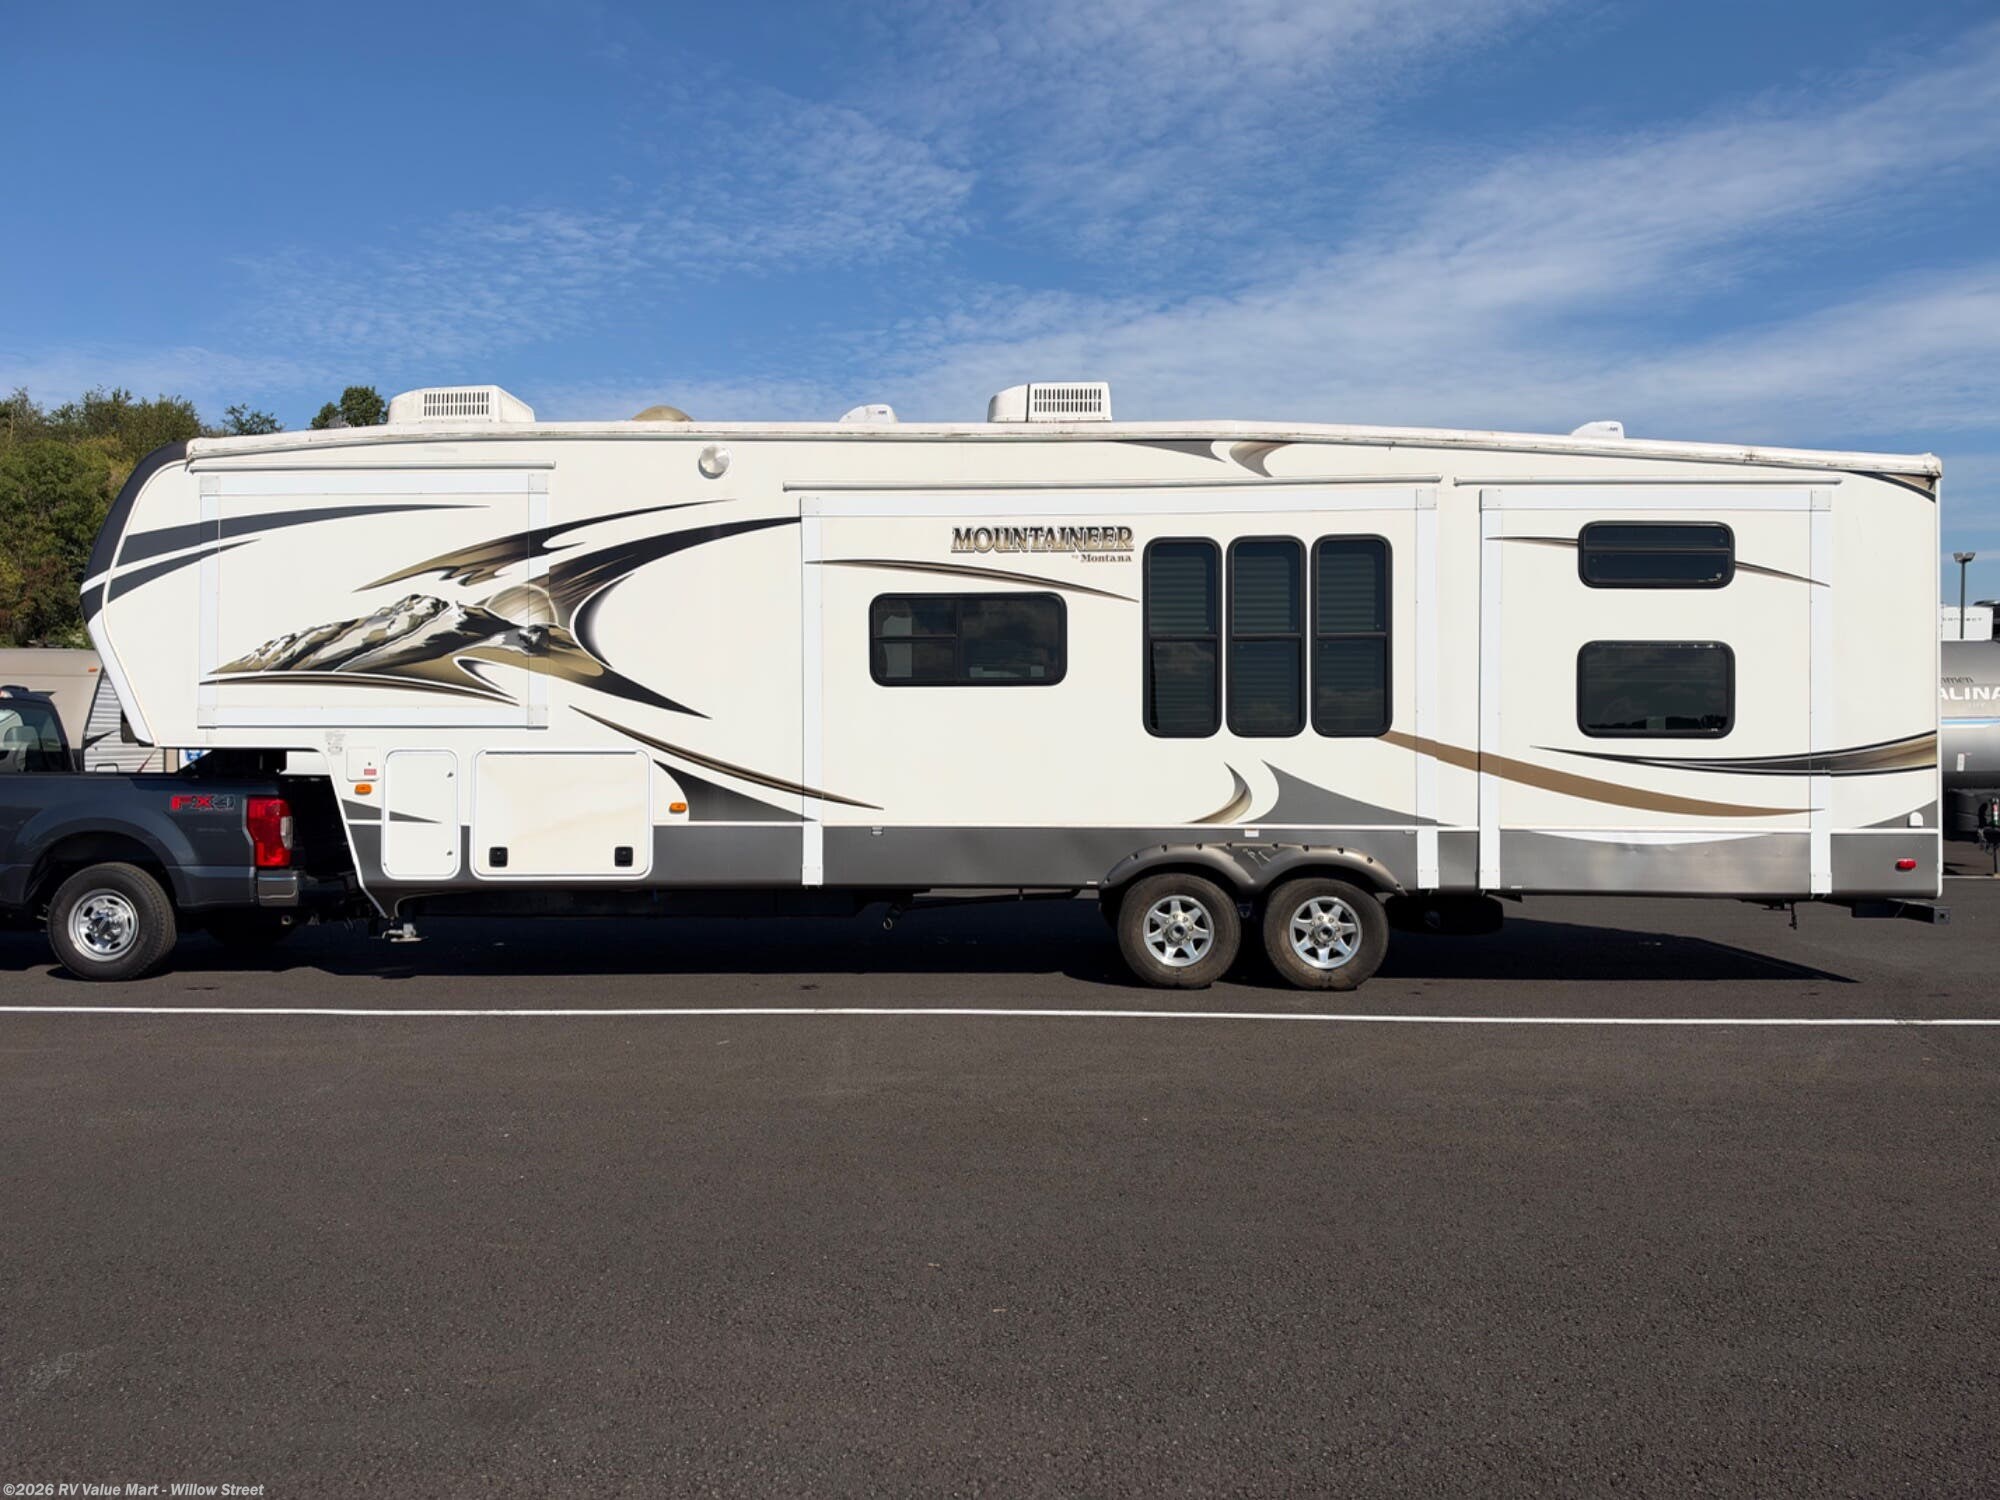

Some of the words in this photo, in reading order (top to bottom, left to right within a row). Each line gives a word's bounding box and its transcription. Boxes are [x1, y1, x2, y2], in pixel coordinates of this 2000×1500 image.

[951, 526, 1135, 553] MOUNTAINEER
[1081, 553, 1132, 563] Montana
[170, 793, 235, 812] FX4
